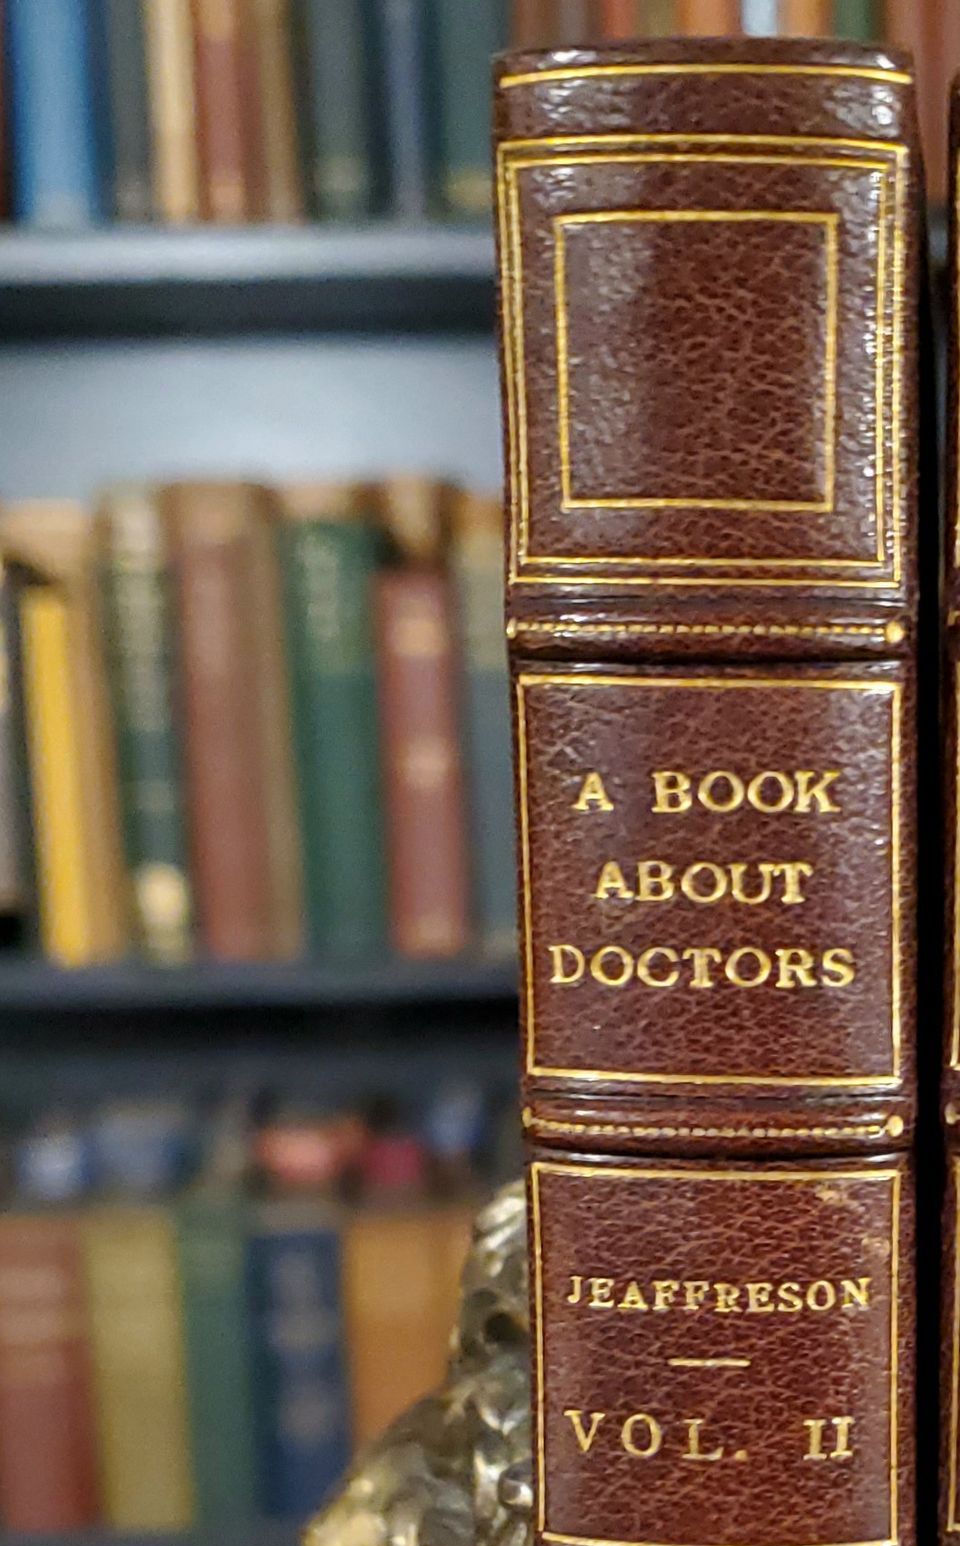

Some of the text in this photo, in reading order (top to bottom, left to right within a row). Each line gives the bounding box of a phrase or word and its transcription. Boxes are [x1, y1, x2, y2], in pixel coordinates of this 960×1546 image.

[573, 770, 841, 813] A BOOK
[594, 860, 814, 904] ABOUT
[547, 944, 855, 988] DOCTORS
[567, 1275, 873, 1313] JEAFFRESON
[564, 1409, 855, 1461] VOL. II
